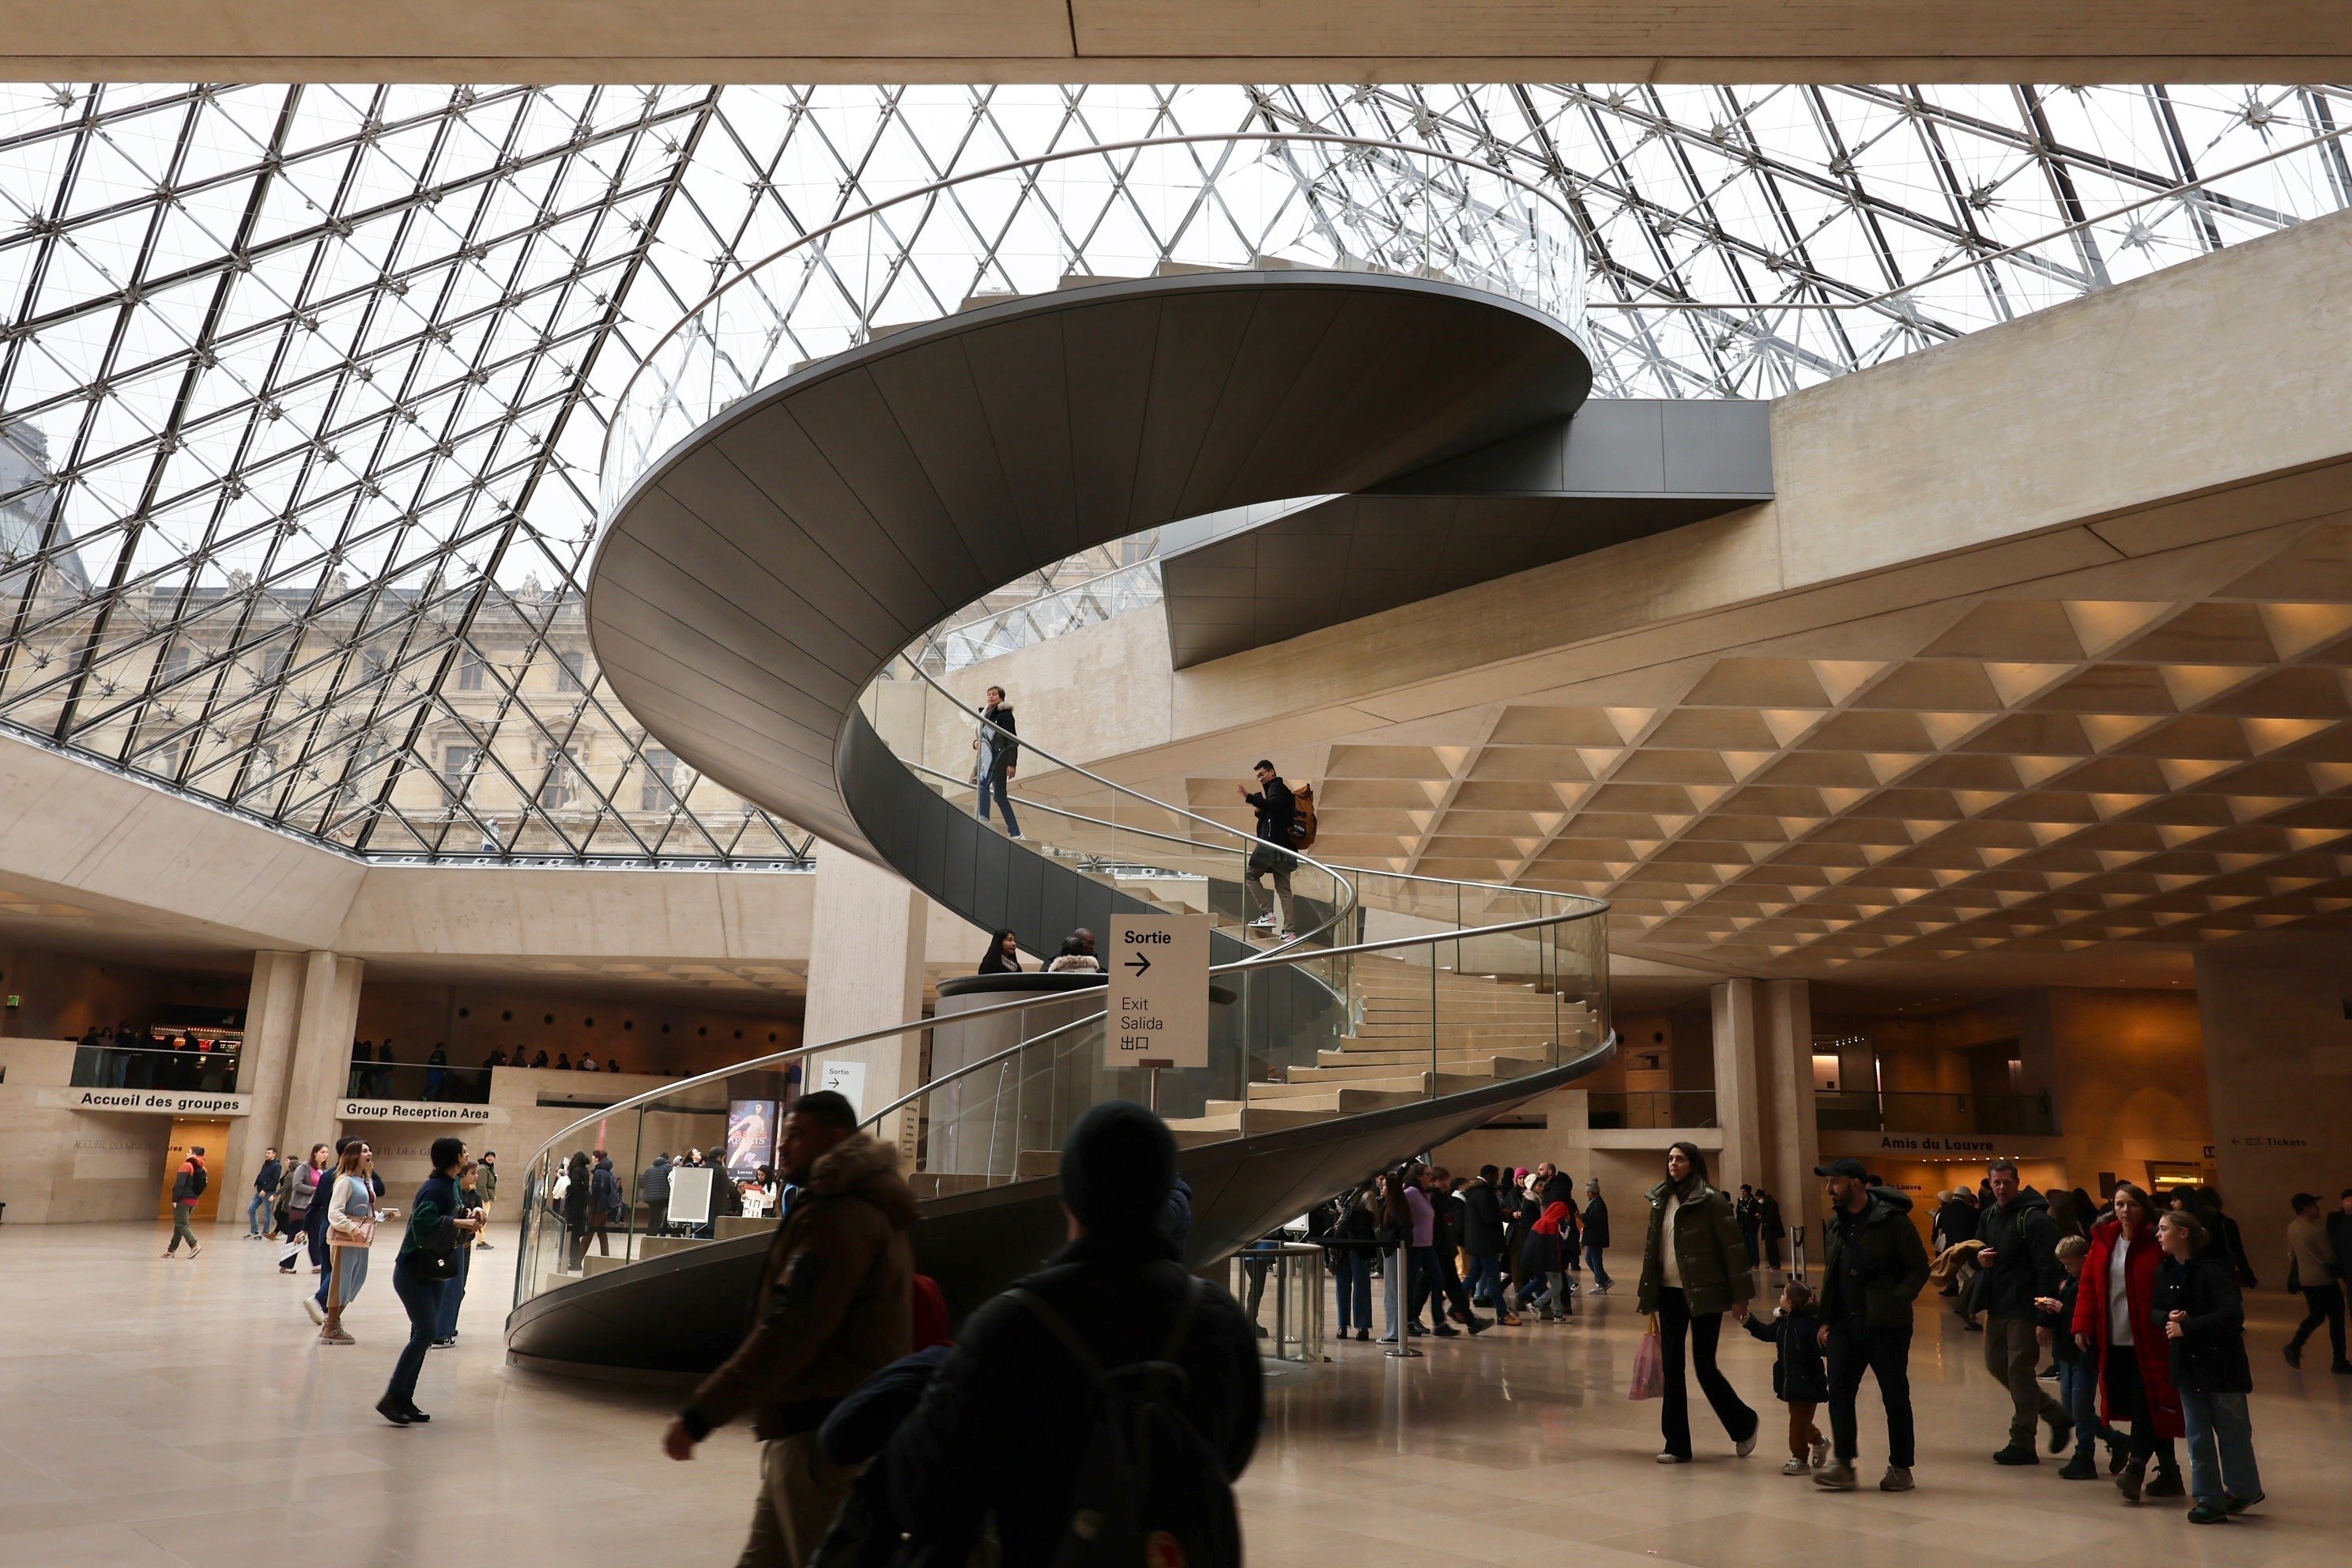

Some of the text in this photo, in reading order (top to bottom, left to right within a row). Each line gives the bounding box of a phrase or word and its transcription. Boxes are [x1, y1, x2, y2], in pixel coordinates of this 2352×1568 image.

[1124, 930, 1171, 944] Sortie
[1122, 997, 1148, 1010] Exit
[1121, 1016, 1163, 1030] Salida
[1121, 1035, 1148, 1050] 出口
[81, 1092, 239, 1111] Accueil des groupes
[346, 1103, 489, 1119] Group Reception Area
[1881, 1136, 1994, 1151] Amis du Louvre
[2266, 1137, 2307, 1146] Tickets
